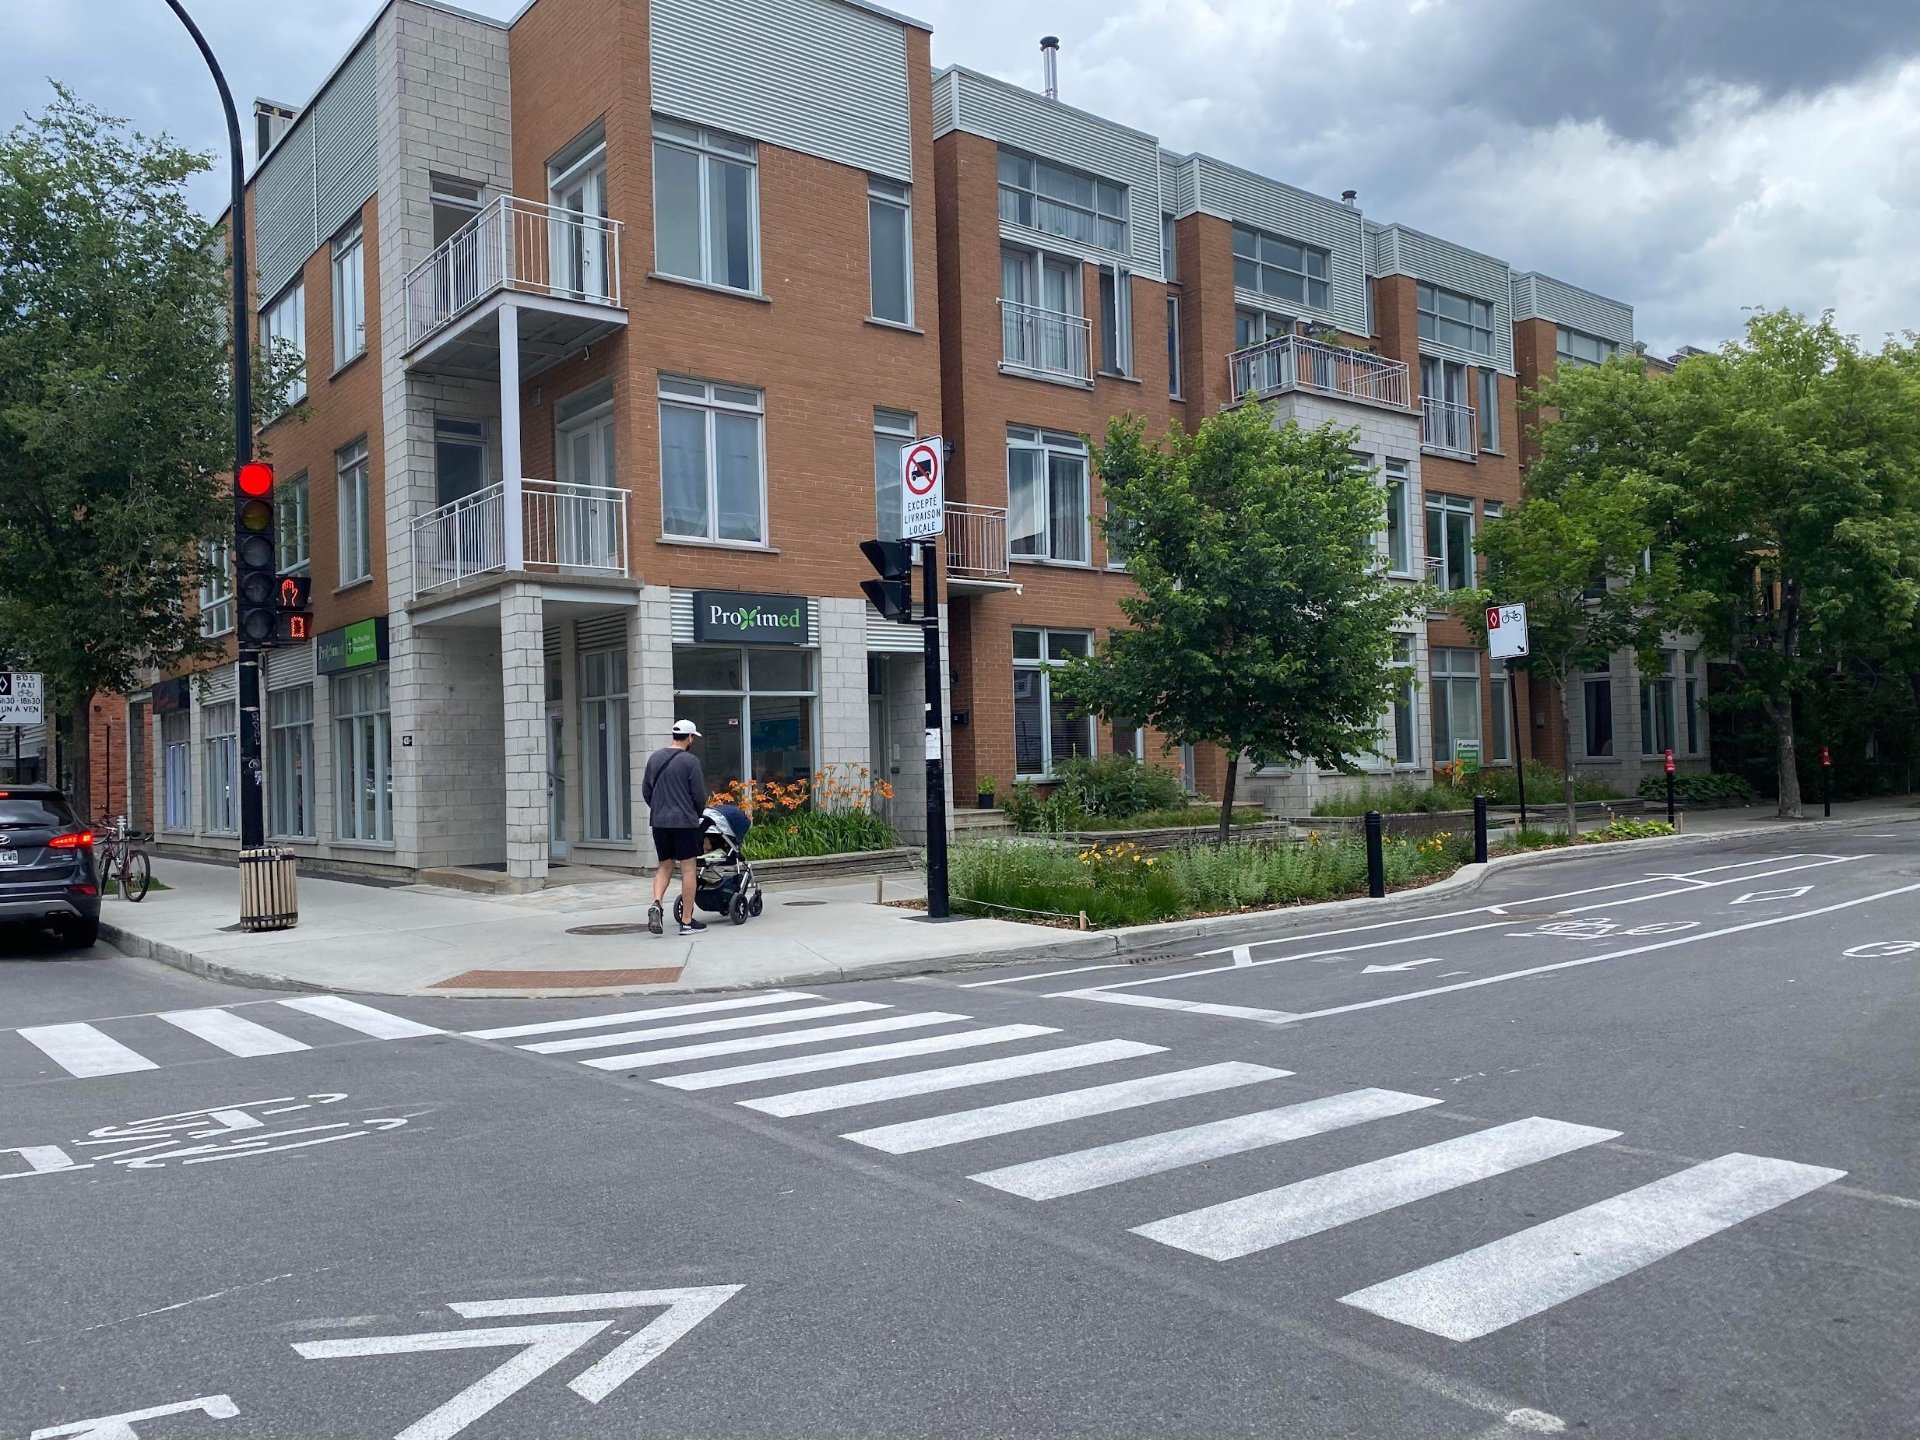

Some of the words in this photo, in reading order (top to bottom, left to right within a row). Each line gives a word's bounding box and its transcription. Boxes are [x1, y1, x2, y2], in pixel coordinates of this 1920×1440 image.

[908, 494, 937, 511] EXCEPTÉ
[904, 508, 941, 524] LIVRAISON
[909, 521, 936, 535] LOCALE
